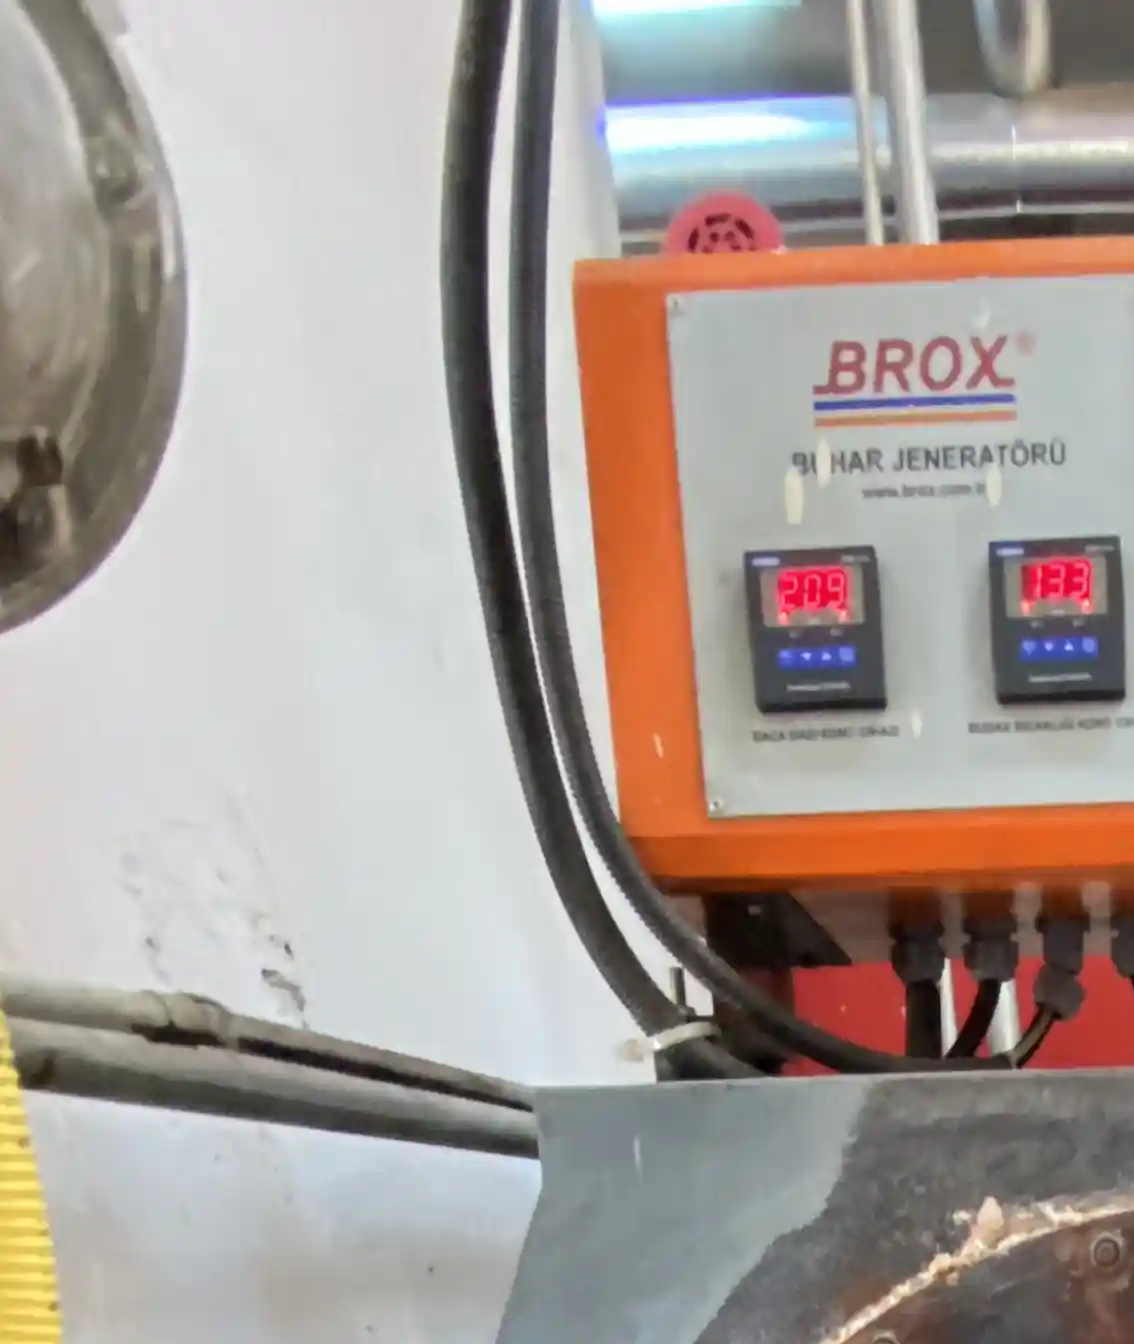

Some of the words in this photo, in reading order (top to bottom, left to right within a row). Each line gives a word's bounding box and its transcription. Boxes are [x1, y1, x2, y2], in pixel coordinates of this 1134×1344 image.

[812, 335, 1016, 395] BROX
[892, 437, 1067, 472] JENERATÖRÜ
[779, 572, 847, 609] 209
[1031, 562, 1091, 600] 133
